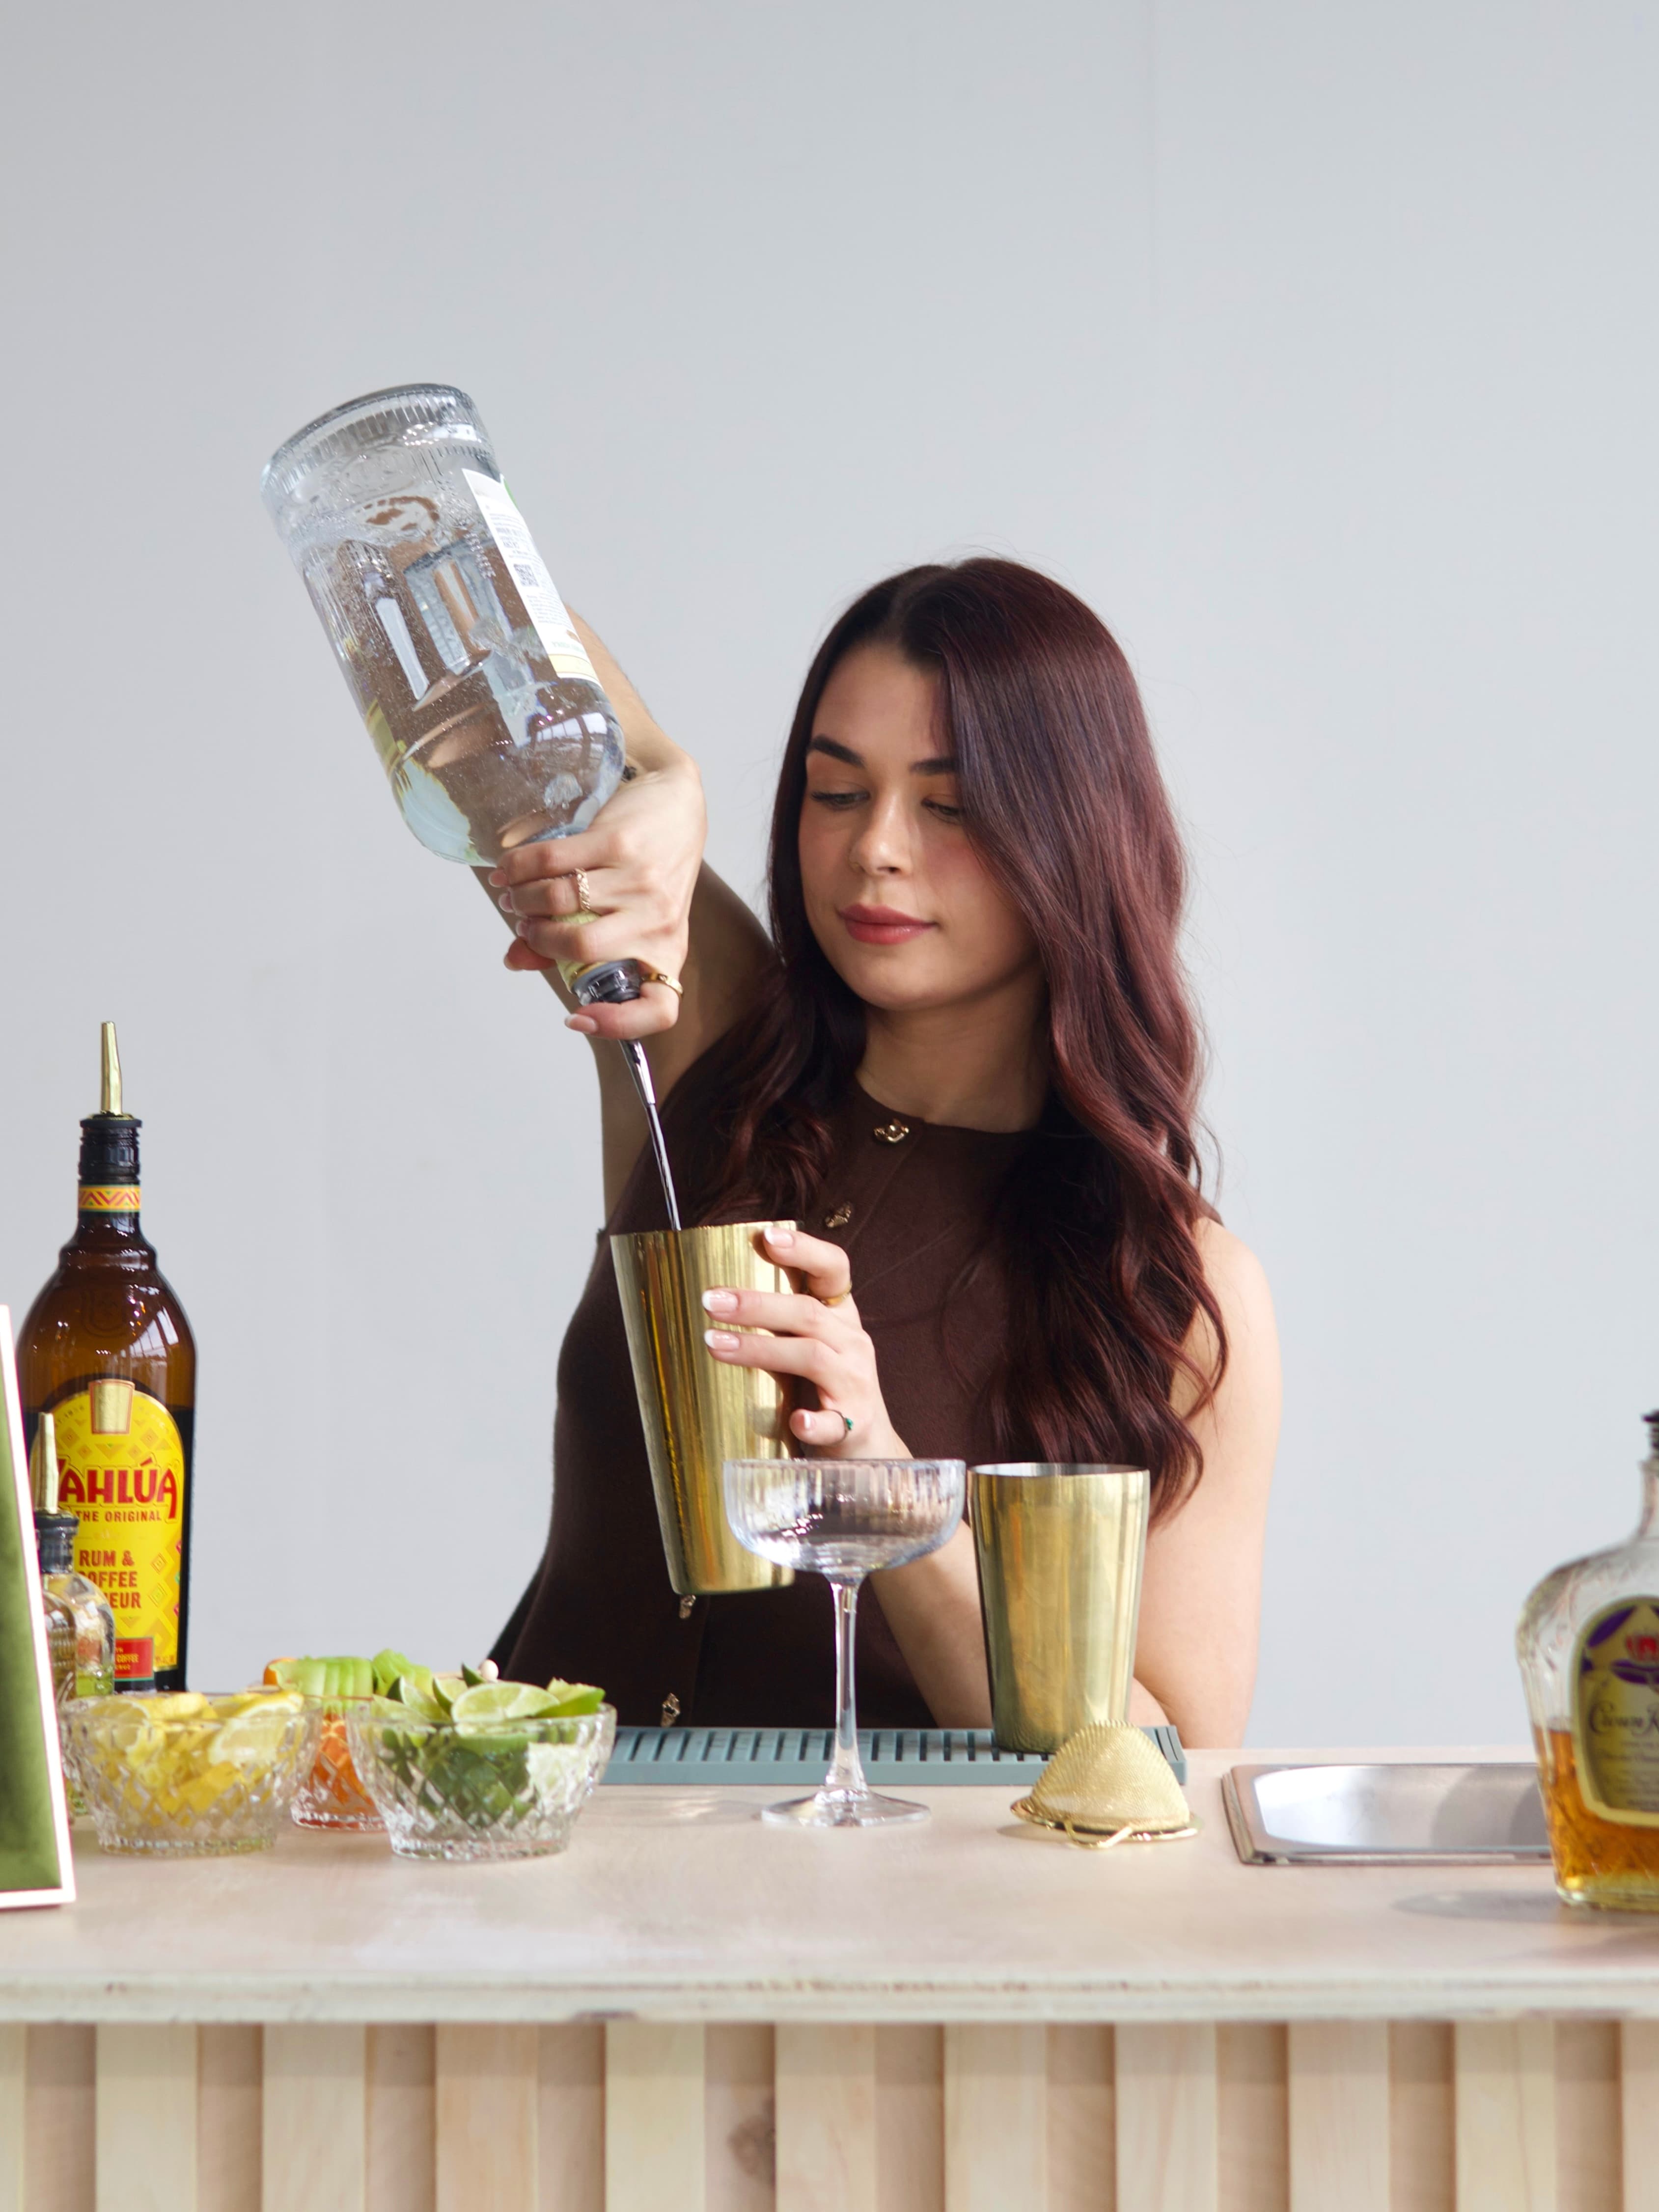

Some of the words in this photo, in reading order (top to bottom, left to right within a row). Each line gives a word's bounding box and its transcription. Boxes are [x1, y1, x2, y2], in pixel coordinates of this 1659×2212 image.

[57, 1457, 177, 1519] AHLÚA
[76, 1511, 99, 1521] THE
[105, 1510, 161, 1522] ORIGINAL
[79, 1549, 116, 1567] RUM
[122, 1550, 134, 1567] &
[78, 1571, 138, 1588] OFFEE
